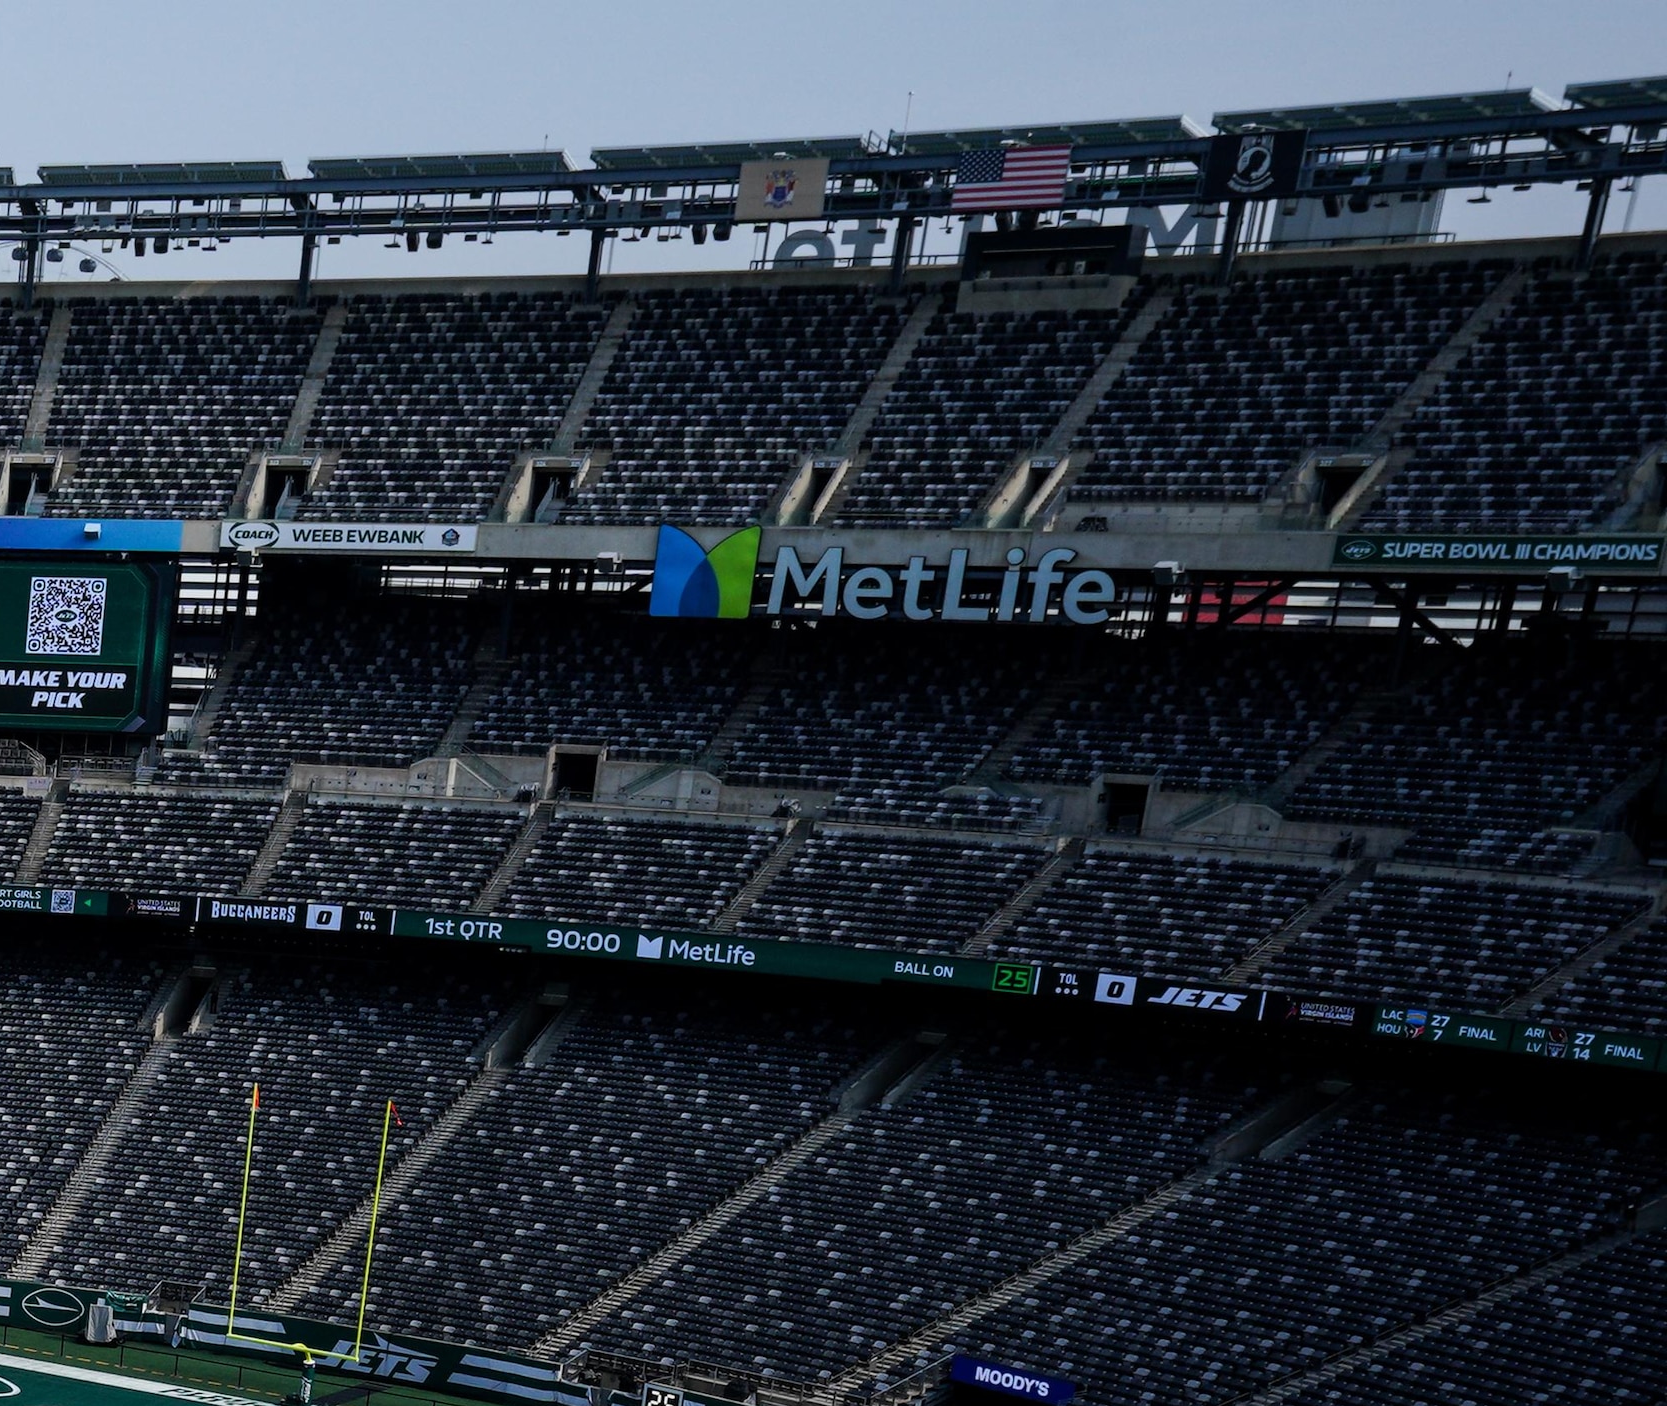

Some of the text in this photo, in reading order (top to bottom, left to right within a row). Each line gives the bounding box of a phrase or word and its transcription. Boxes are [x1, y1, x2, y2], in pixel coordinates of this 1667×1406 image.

[233, 529, 424, 544] COACH WEEB EWBANK
[1381, 542, 1447, 559] SUPER
[1450, 543, 1513, 559] BOWL
[1533, 544, 1658, 561] CHAMPIONS
[767, 547, 1115, 623] MetLife
[66, 672, 127, 688] YOUR
[31, 692, 86, 708] PICK
[14, 890, 42, 899] GIRLS
[211, 901, 376, 925] BUCCANEERS 0 TOL
[425, 918, 755, 966] 1st QTR 90:00 MetLife
[894, 961, 1027, 988] BALL ON 25
[1059, 973, 1248, 1012] TOL 0 JETS
[1381, 1009, 1450, 1027] LAC 27
[1377, 1023, 1443, 1041] HOU 7
[1458, 1026, 1497, 1041] FINAL
[1524, 1027, 1595, 1045] ARI 27
[1526, 1042, 1591, 1060] LV 14
[1604, 1044, 1644, 1061] FINAL
[309, 1338, 438, 1383] JETS
[974, 1366, 1049, 1396] MOODY'S
